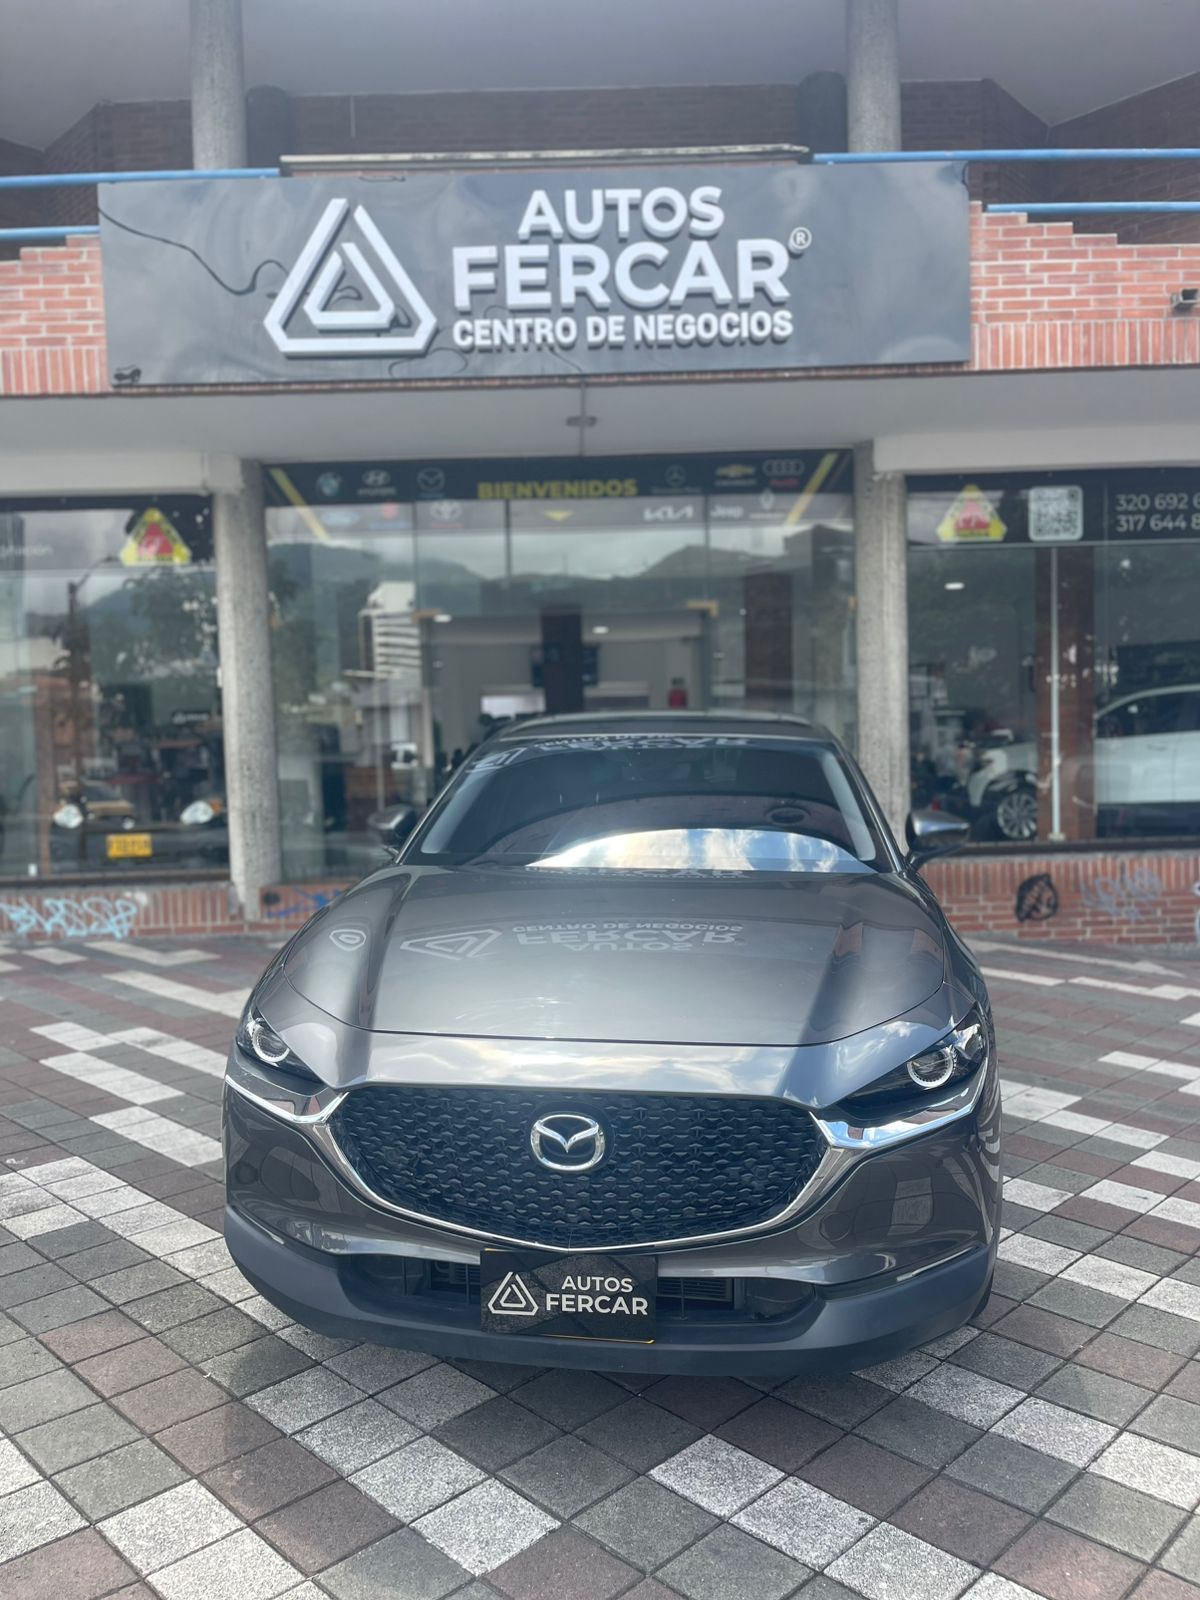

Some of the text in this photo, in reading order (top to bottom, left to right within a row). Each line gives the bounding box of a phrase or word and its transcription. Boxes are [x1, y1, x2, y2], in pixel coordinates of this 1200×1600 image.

[518, 186, 725, 240] AUTOS
[452, 238, 791, 312] FERCAR
[452, 310, 794, 349] CENTRO DE NEGOCIOS
[477, 479, 638, 499] BIENVENIDOS
[1115, 493, 1151, 511] 320
[1154, 492, 1189, 510] 692
[1116, 513, 1146, 532] 317
[1149, 513, 1187, 532] 644
[561, 1275, 633, 1293] AUTOS
[545, 1293, 649, 1316] FERCAR
